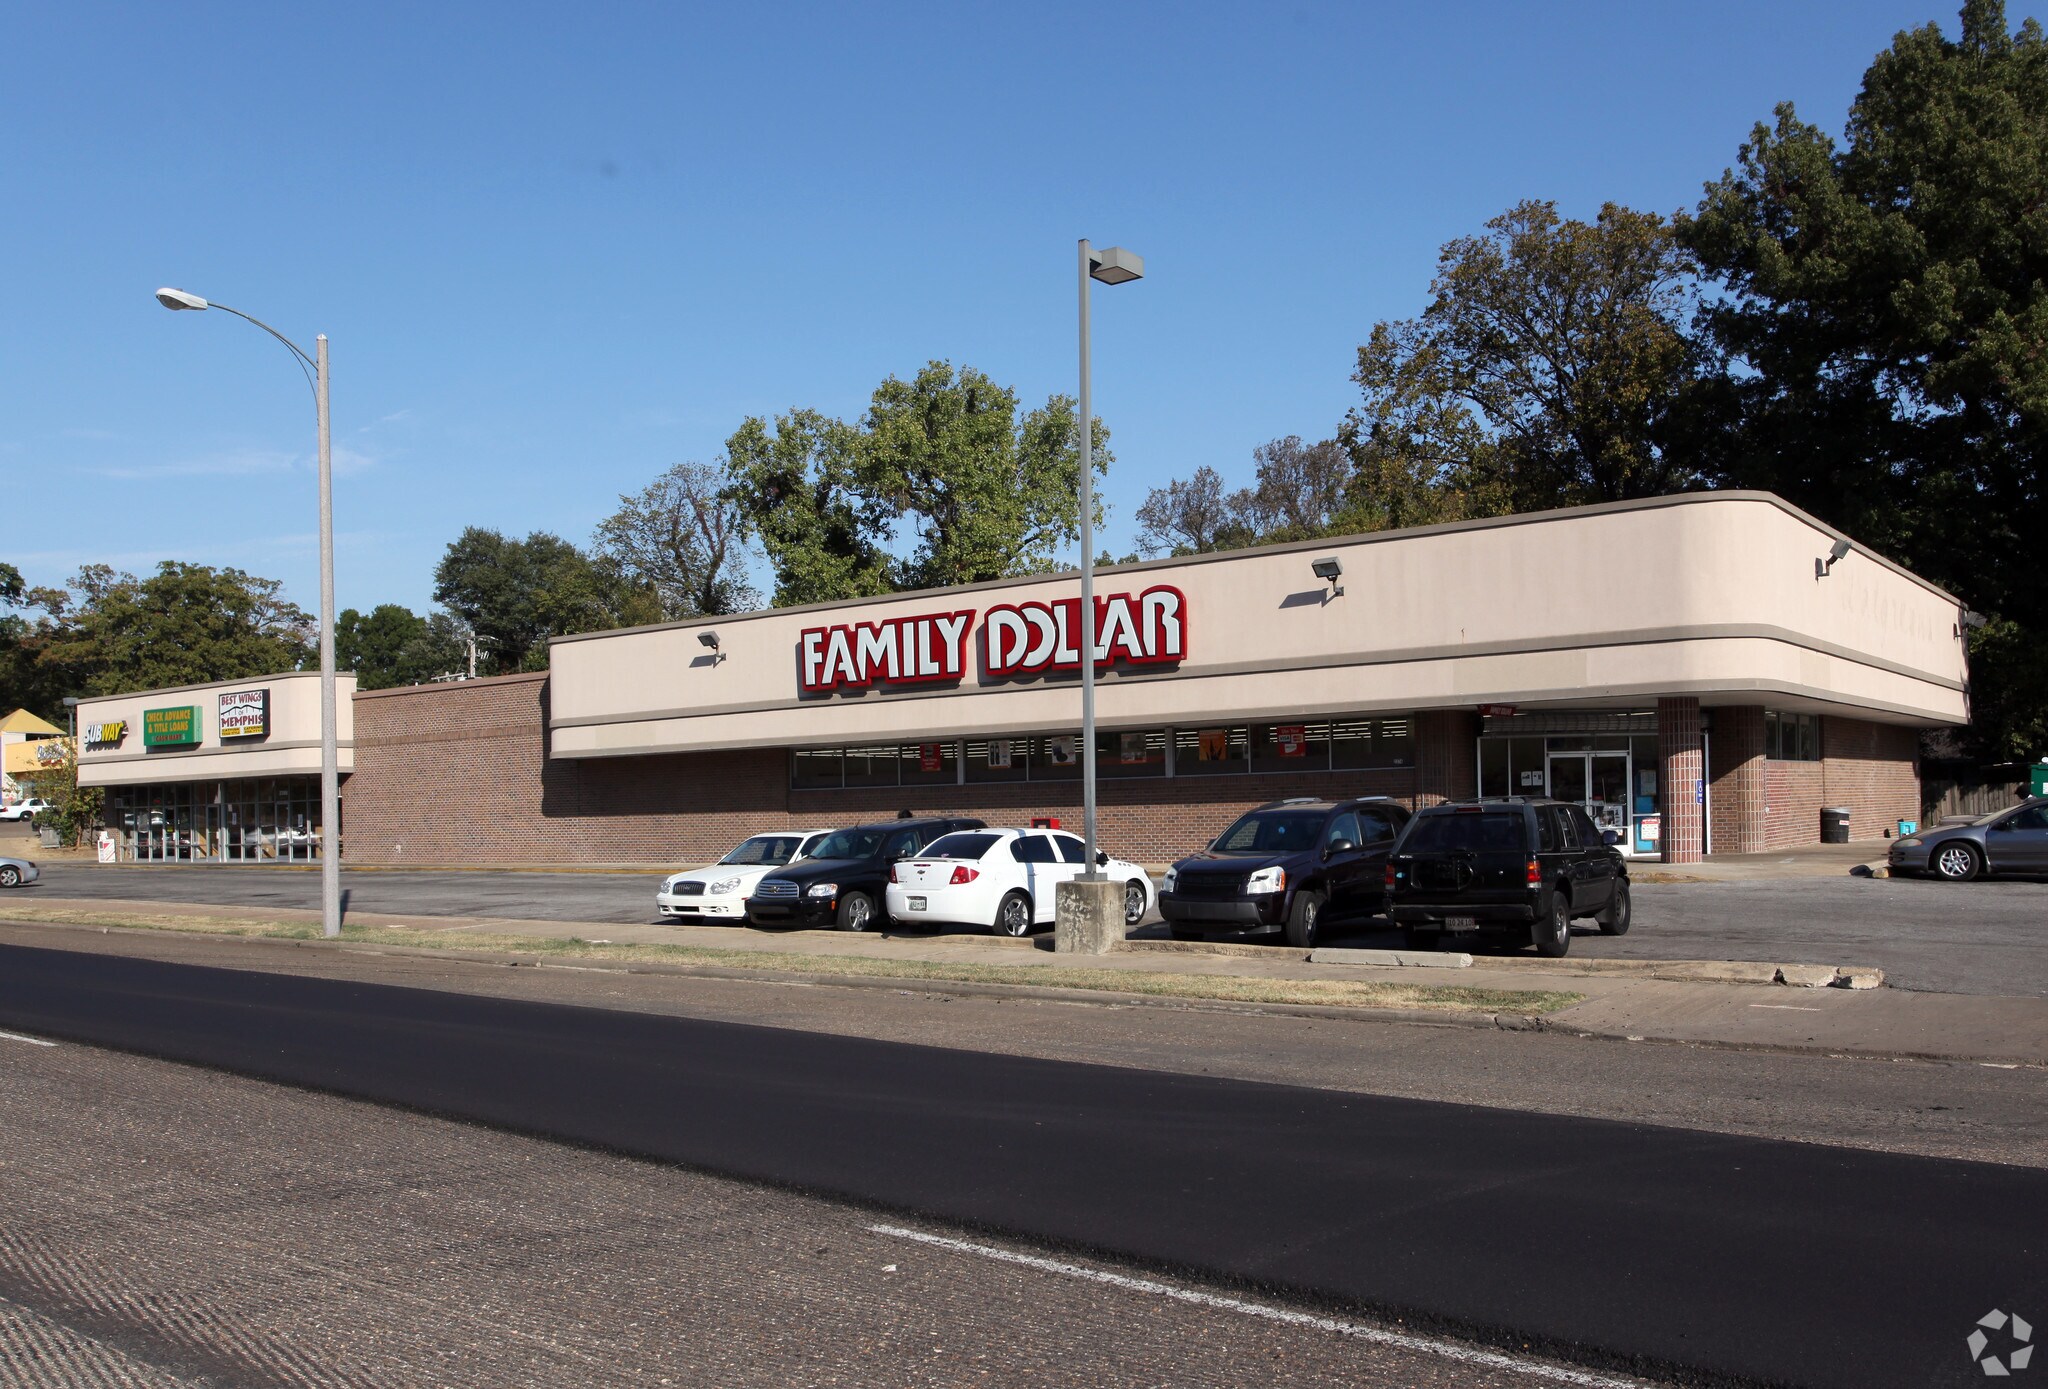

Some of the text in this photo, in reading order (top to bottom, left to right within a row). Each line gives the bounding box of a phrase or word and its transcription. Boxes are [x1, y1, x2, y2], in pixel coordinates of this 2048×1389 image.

[803, 590, 1181, 687] FAMILY DOLAR
[221, 692, 262, 706] BEST WINGS
[147, 709, 190, 722] CHECK ADVANCE
[222, 714, 263, 728] MEMPHIS
[84, 722, 124, 743] SUBWAY
[154, 722, 169, 733] TITLE
[169, 721, 188, 732] LOANS
